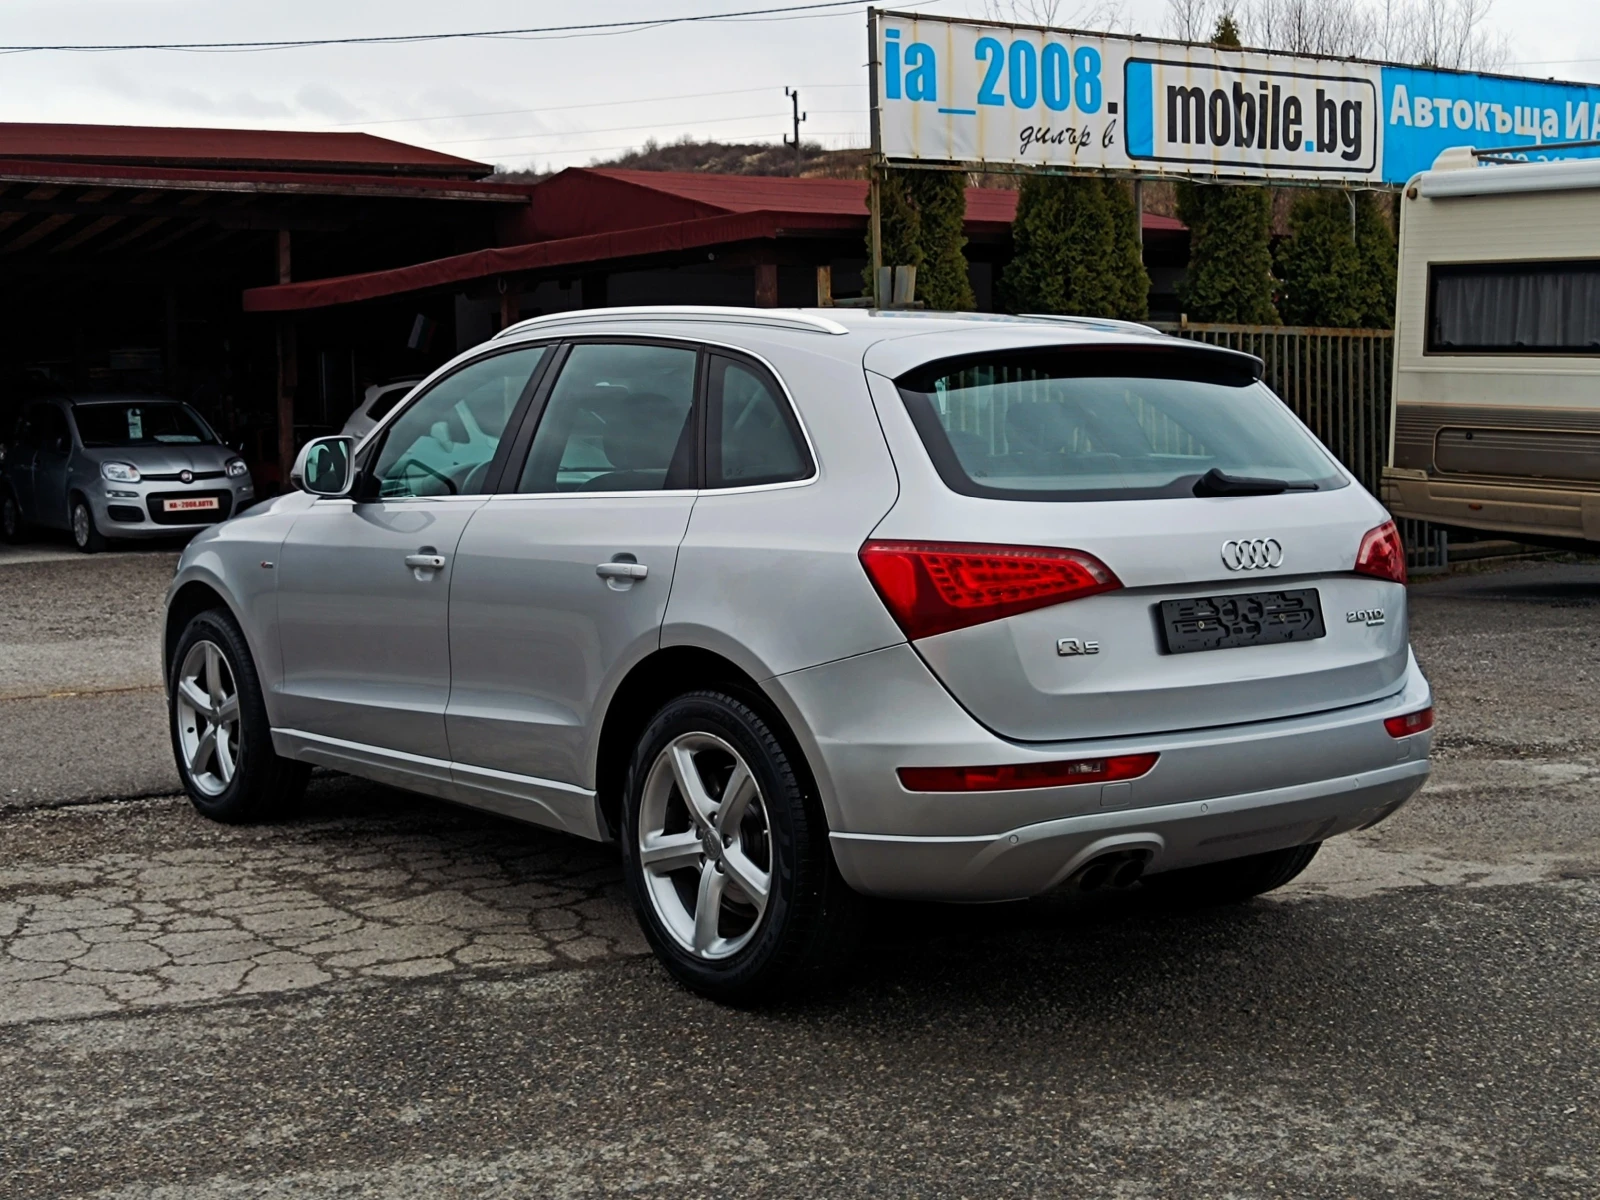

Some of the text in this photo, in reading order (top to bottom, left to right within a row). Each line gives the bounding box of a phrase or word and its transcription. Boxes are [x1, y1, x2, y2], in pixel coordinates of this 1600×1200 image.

[1167, 80, 1362, 161] mobile.bg
[1389, 84, 1558, 145] Автокъща
[1056, 637, 1100, 657] Q5
